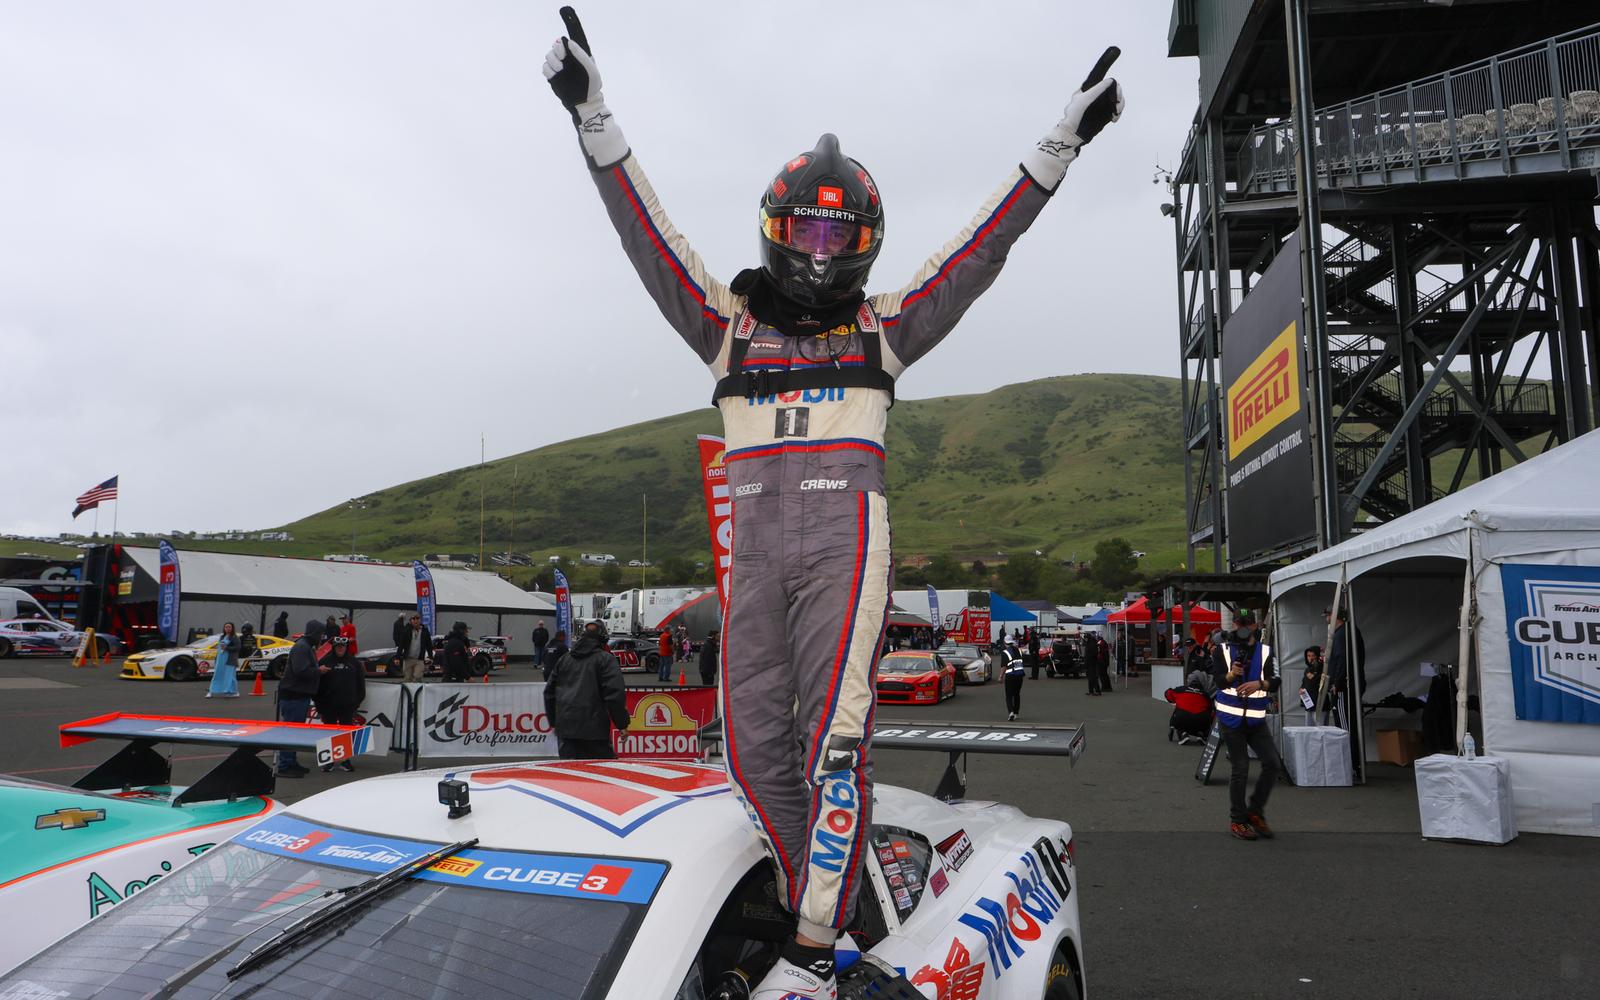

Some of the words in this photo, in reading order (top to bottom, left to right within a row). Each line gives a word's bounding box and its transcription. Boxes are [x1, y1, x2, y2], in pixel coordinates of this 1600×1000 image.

[822, 191, 838, 202] JBL
[793, 207, 855, 222] SCHUBERTH
[1232, 347, 1290, 442] PIRELLI
[1245, 456, 1261, 478] NOTHING
[1261, 443, 1279, 468] WITHOUT
[1280, 429, 1303, 455] CONTROL
[800, 479, 848, 490] CREWS
[1554, 604, 1581, 613] Trans
[943, 613, 964, 631] 31
[1553, 652, 1598, 661] ARCH
[926, 731, 1038, 742] CARS
[363, 849, 403, 864] Am
[957, 851, 1061, 980] Mobil
